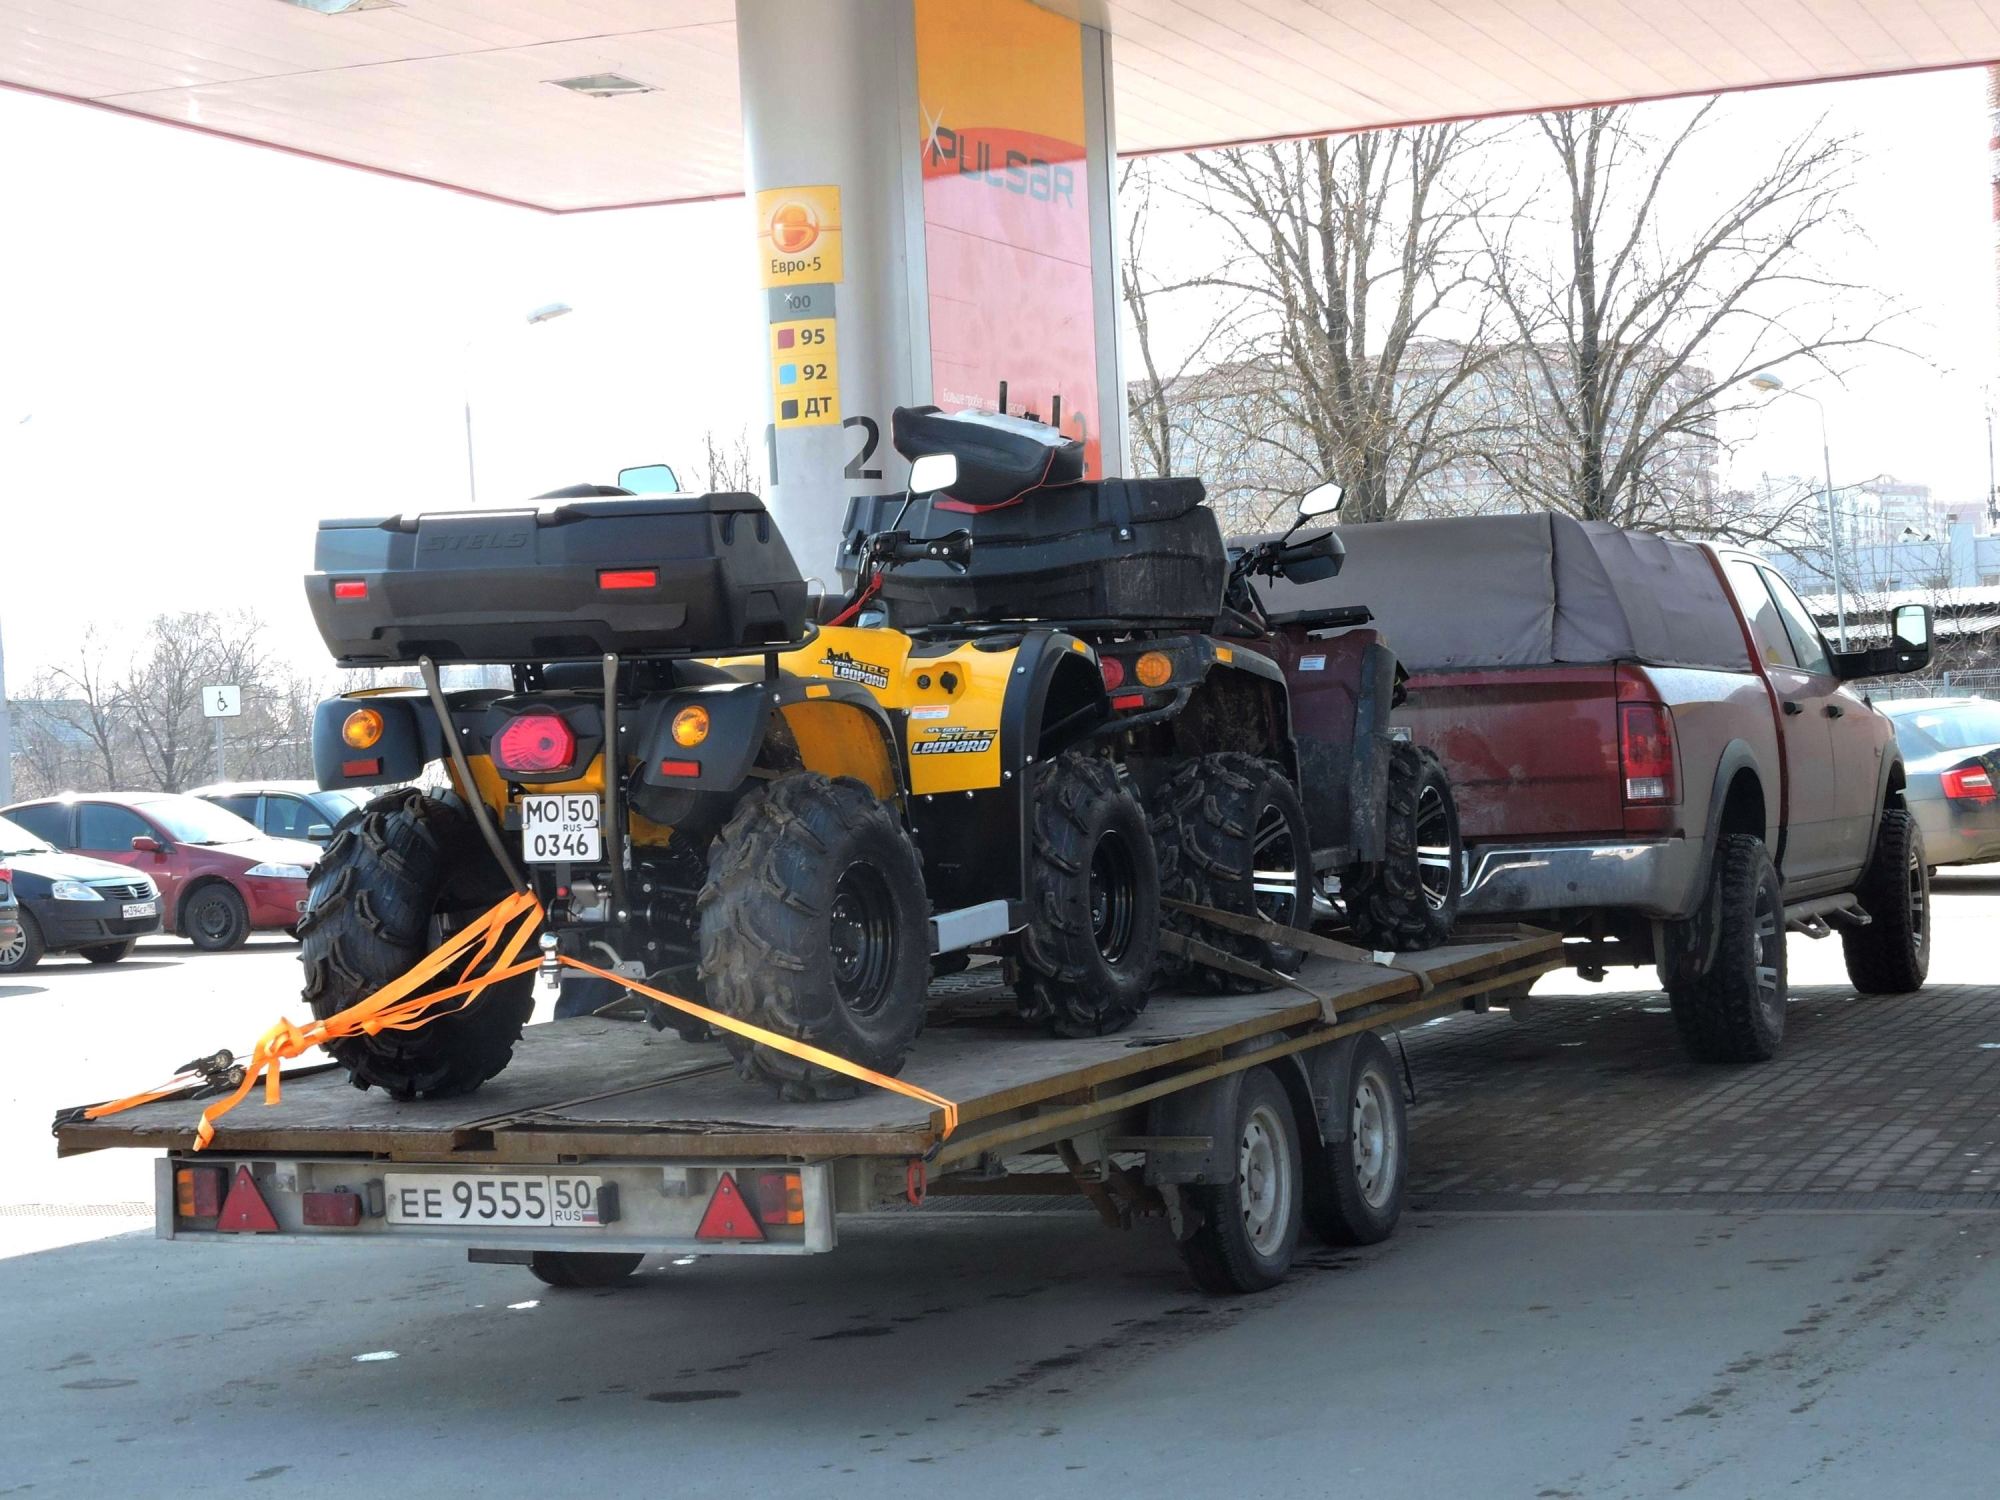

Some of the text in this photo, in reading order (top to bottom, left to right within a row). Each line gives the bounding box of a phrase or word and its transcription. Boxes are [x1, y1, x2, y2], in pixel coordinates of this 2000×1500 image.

[801, 328, 825, 345] 95
[803, 363, 828, 380] 92
[805, 397, 832, 418] ДТ
[843, 415, 883, 480] 2
[423, 533, 529, 551] STELS
[851, 661, 889, 677] STELS
[939, 729, 996, 741] STELS
[568, 800, 594, 822] 50
[563, 824, 582, 832] RUS
[534, 834, 589, 857] 0346
[453, 1181, 545, 1219] 9555
[555, 1180, 591, 1209] 50
[554, 1210, 581, 1221] RUS
